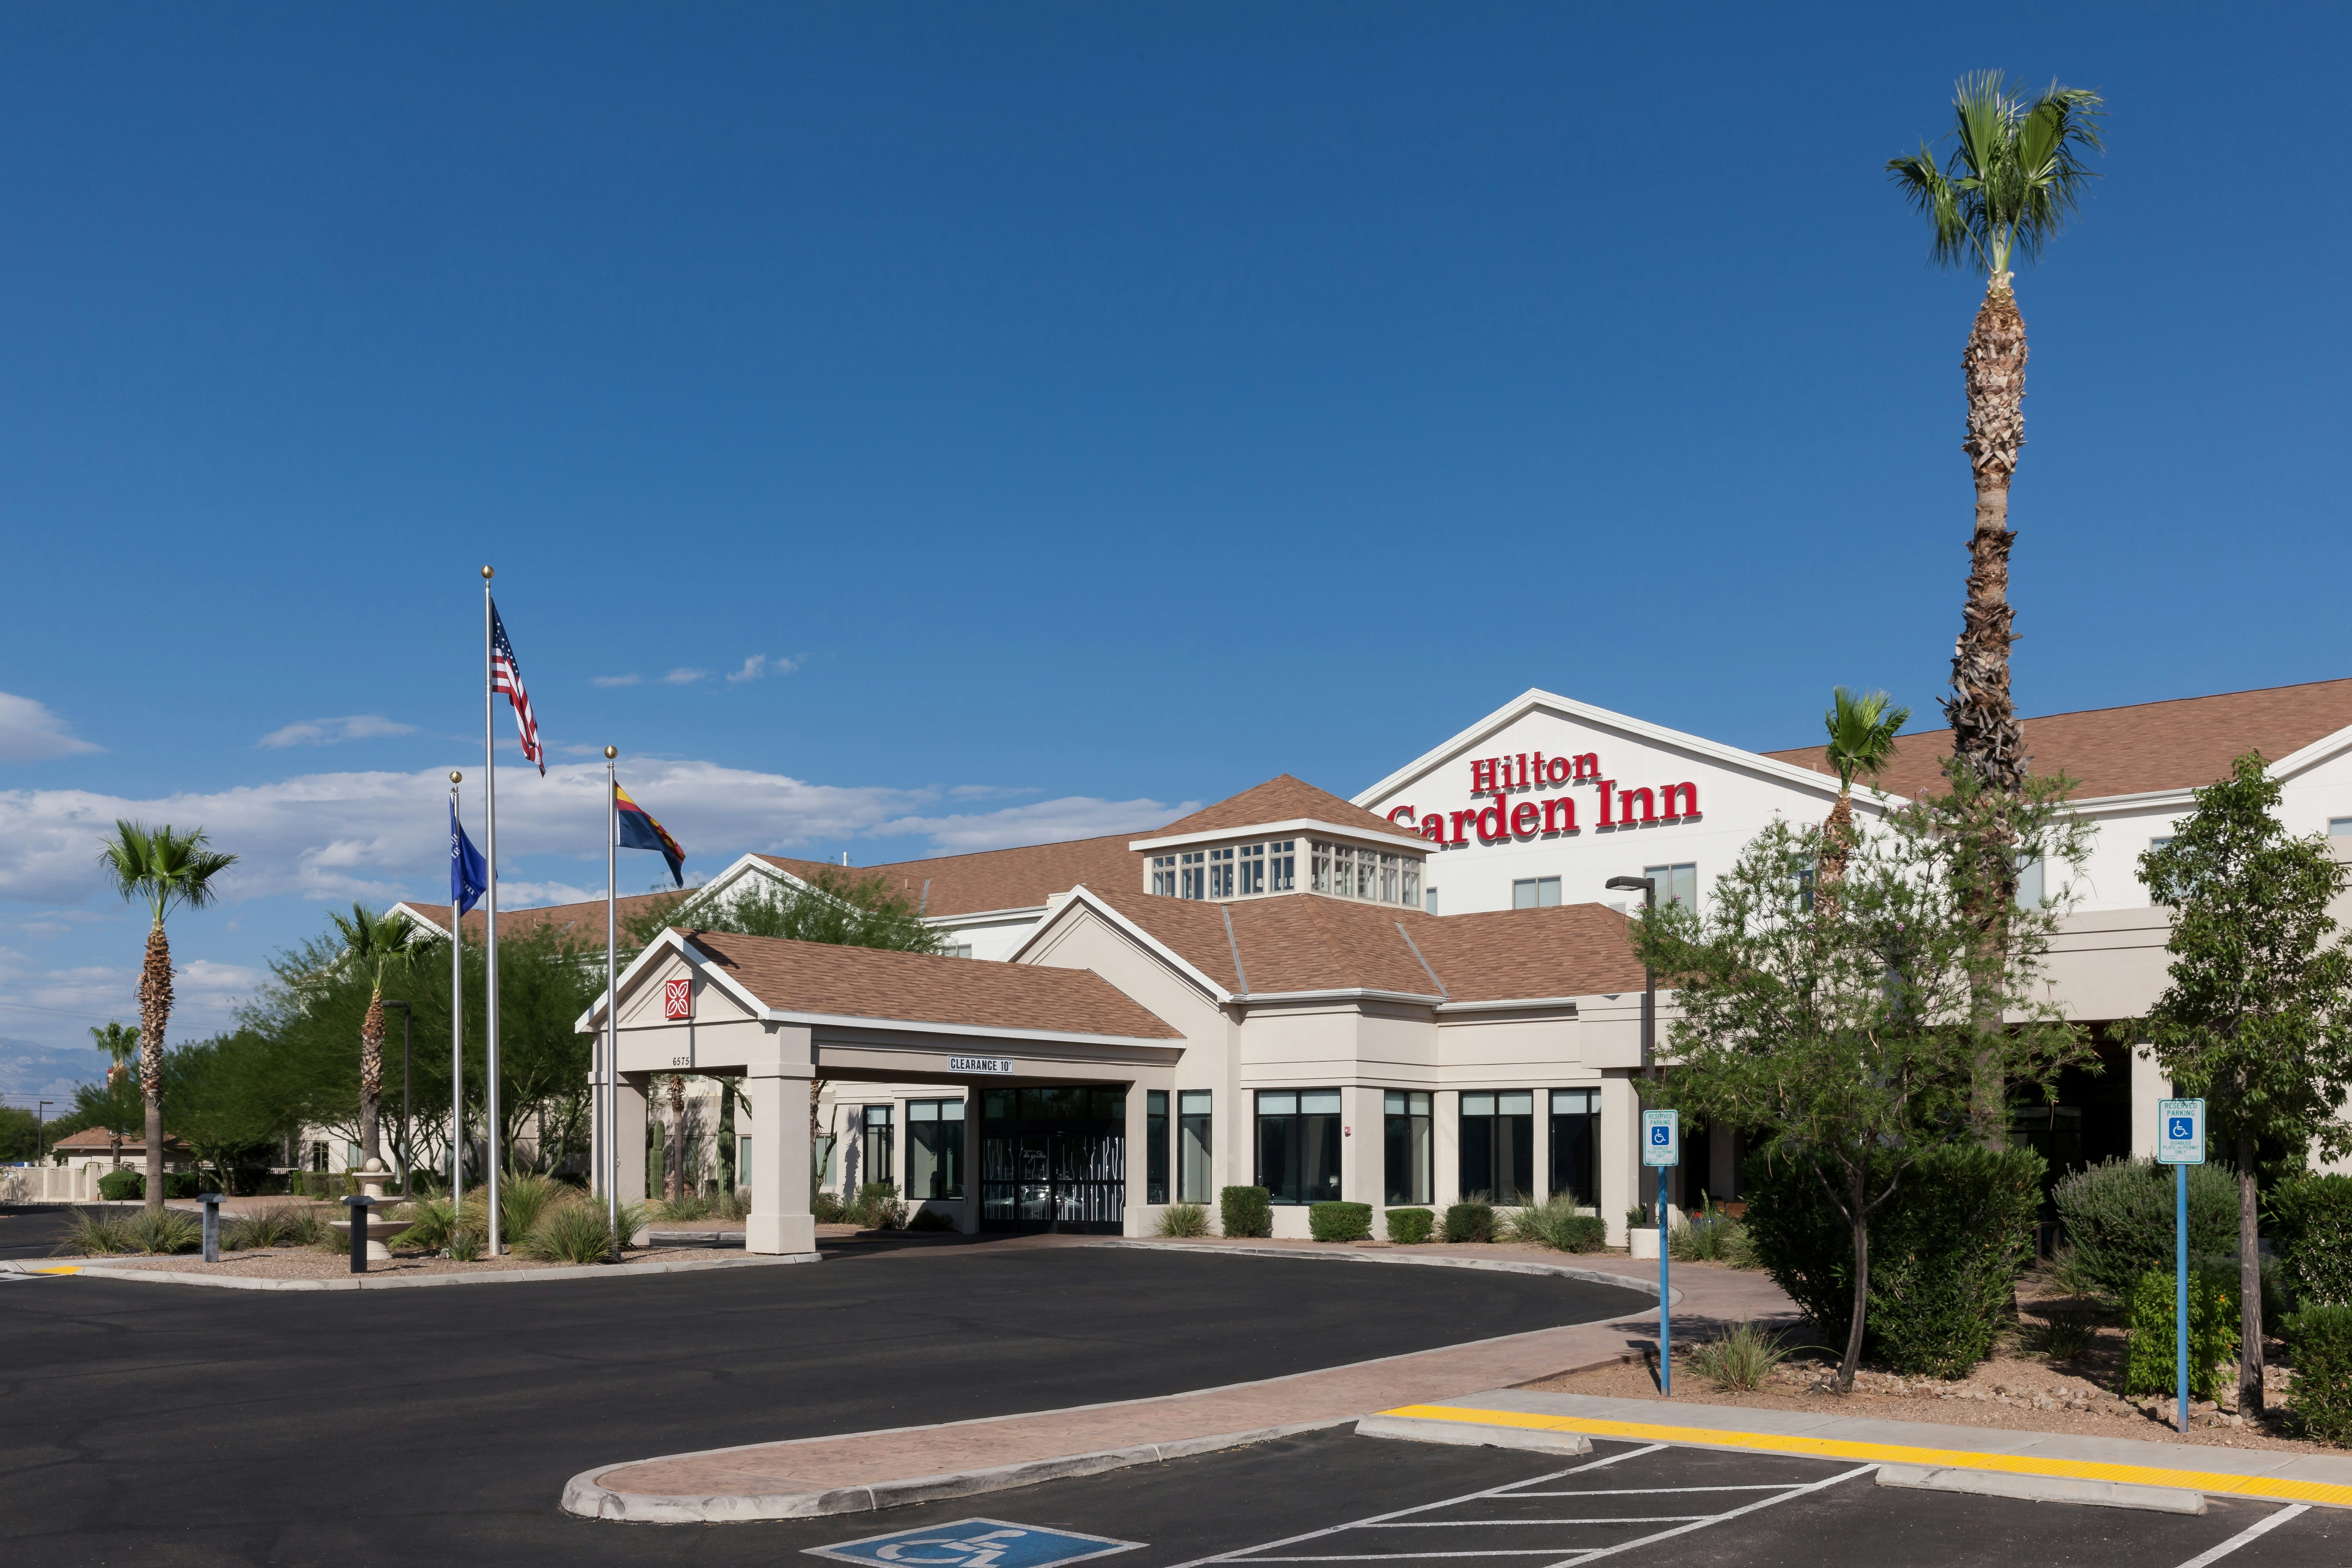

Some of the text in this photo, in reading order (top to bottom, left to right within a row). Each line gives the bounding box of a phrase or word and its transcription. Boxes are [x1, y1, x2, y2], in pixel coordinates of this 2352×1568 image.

[1470, 751, 1602, 793] Hilton
[1387, 780, 1702, 845] Garden Inn
[673, 1057, 689, 1066] 6575
[950, 1058, 1012, 1072] CLEARANCE 10'
